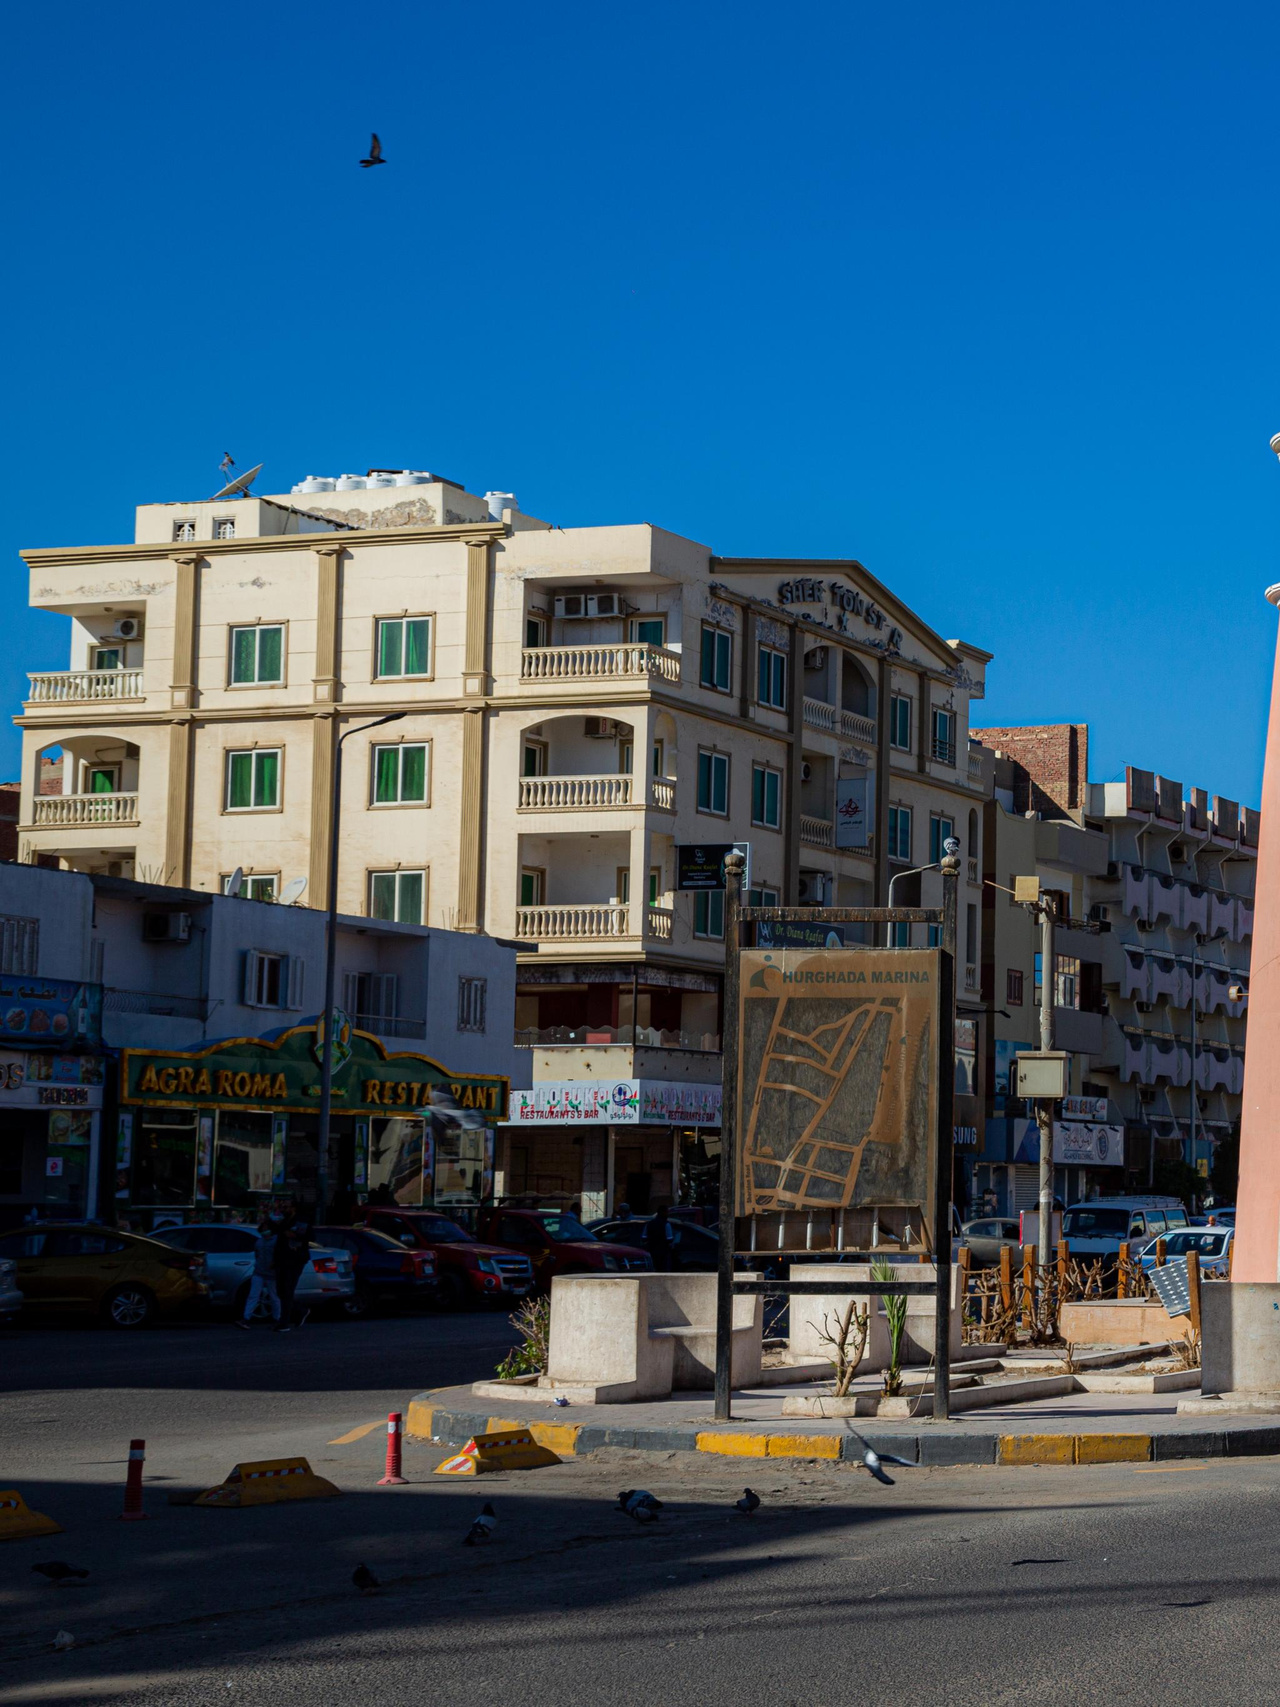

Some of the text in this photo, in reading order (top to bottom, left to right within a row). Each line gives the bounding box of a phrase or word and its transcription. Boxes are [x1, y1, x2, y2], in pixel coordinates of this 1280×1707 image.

[782, 971, 930, 984] HURGHADA MARINA
[139, 1063, 212, 1095] AGRA
[215, 1069, 288, 1099] ROMA
[363, 1079, 500, 1110] RESTARANT
[520, 1110, 576, 1120] RESTAURANTS
[584, 1109, 599, 1119] BAR
